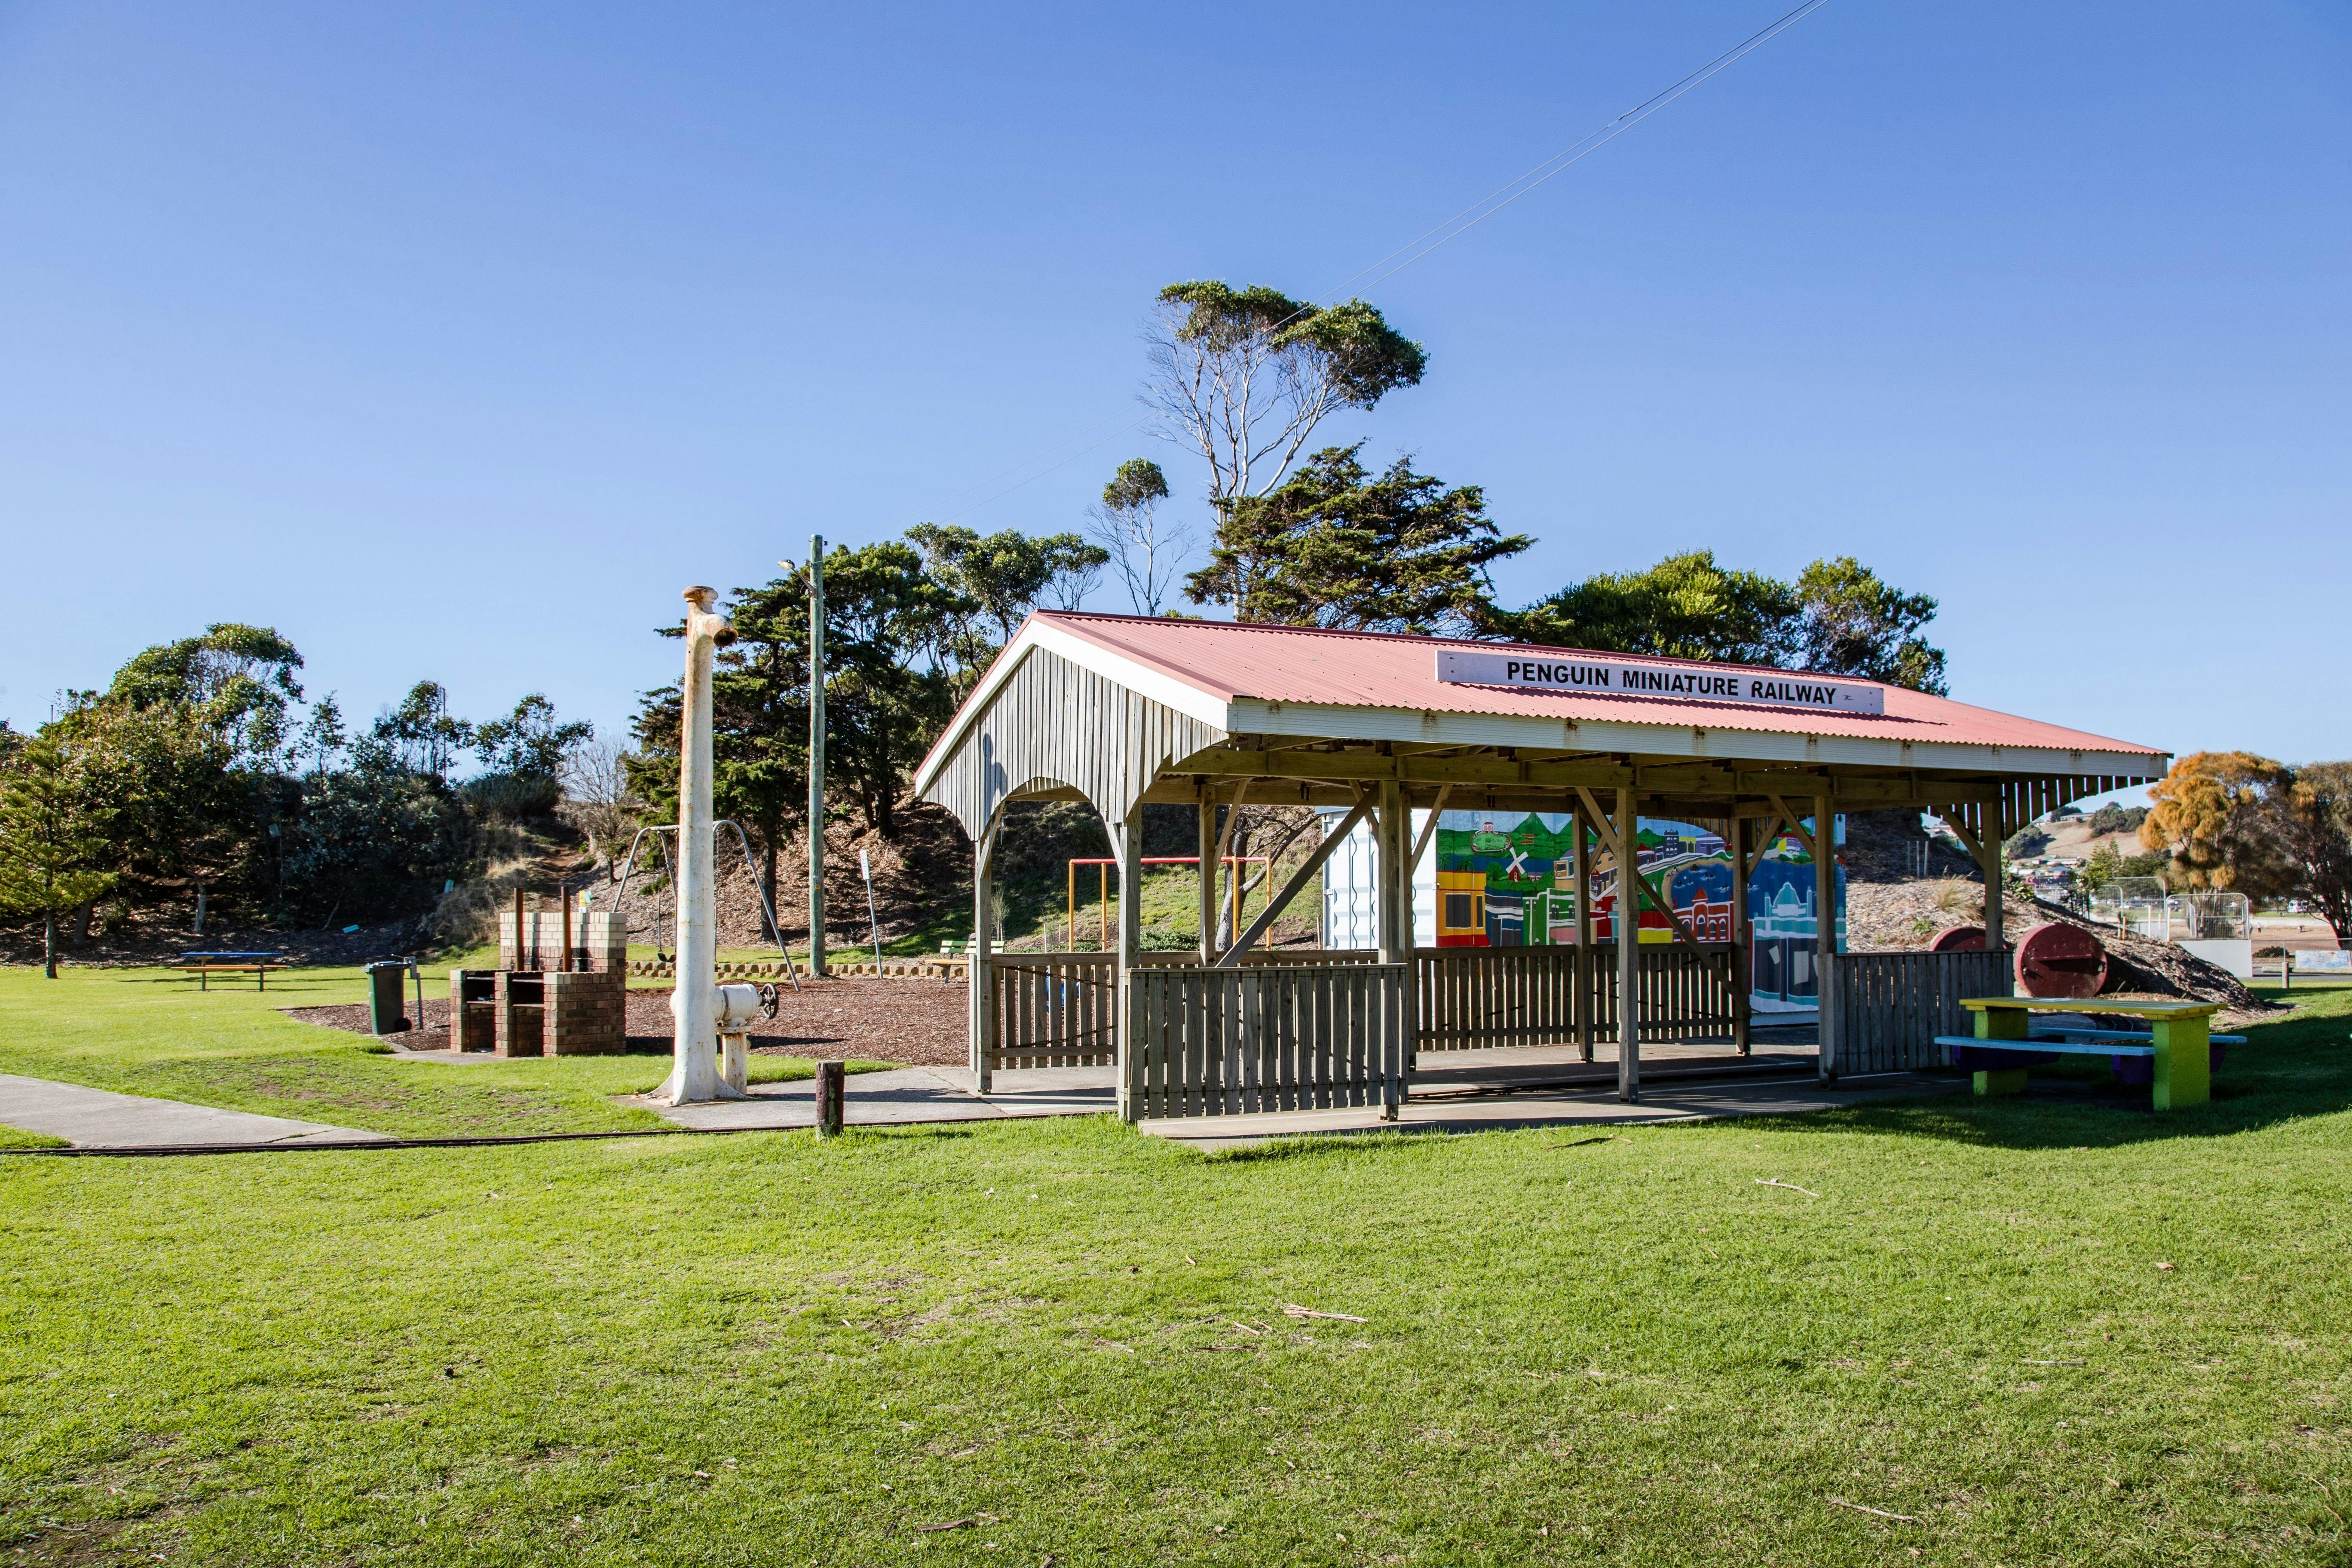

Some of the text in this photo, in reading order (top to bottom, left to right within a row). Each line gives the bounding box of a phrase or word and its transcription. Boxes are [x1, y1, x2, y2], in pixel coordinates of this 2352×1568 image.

[1507, 662, 1837, 704] PENGUIN MINIATURE RAILWAY
